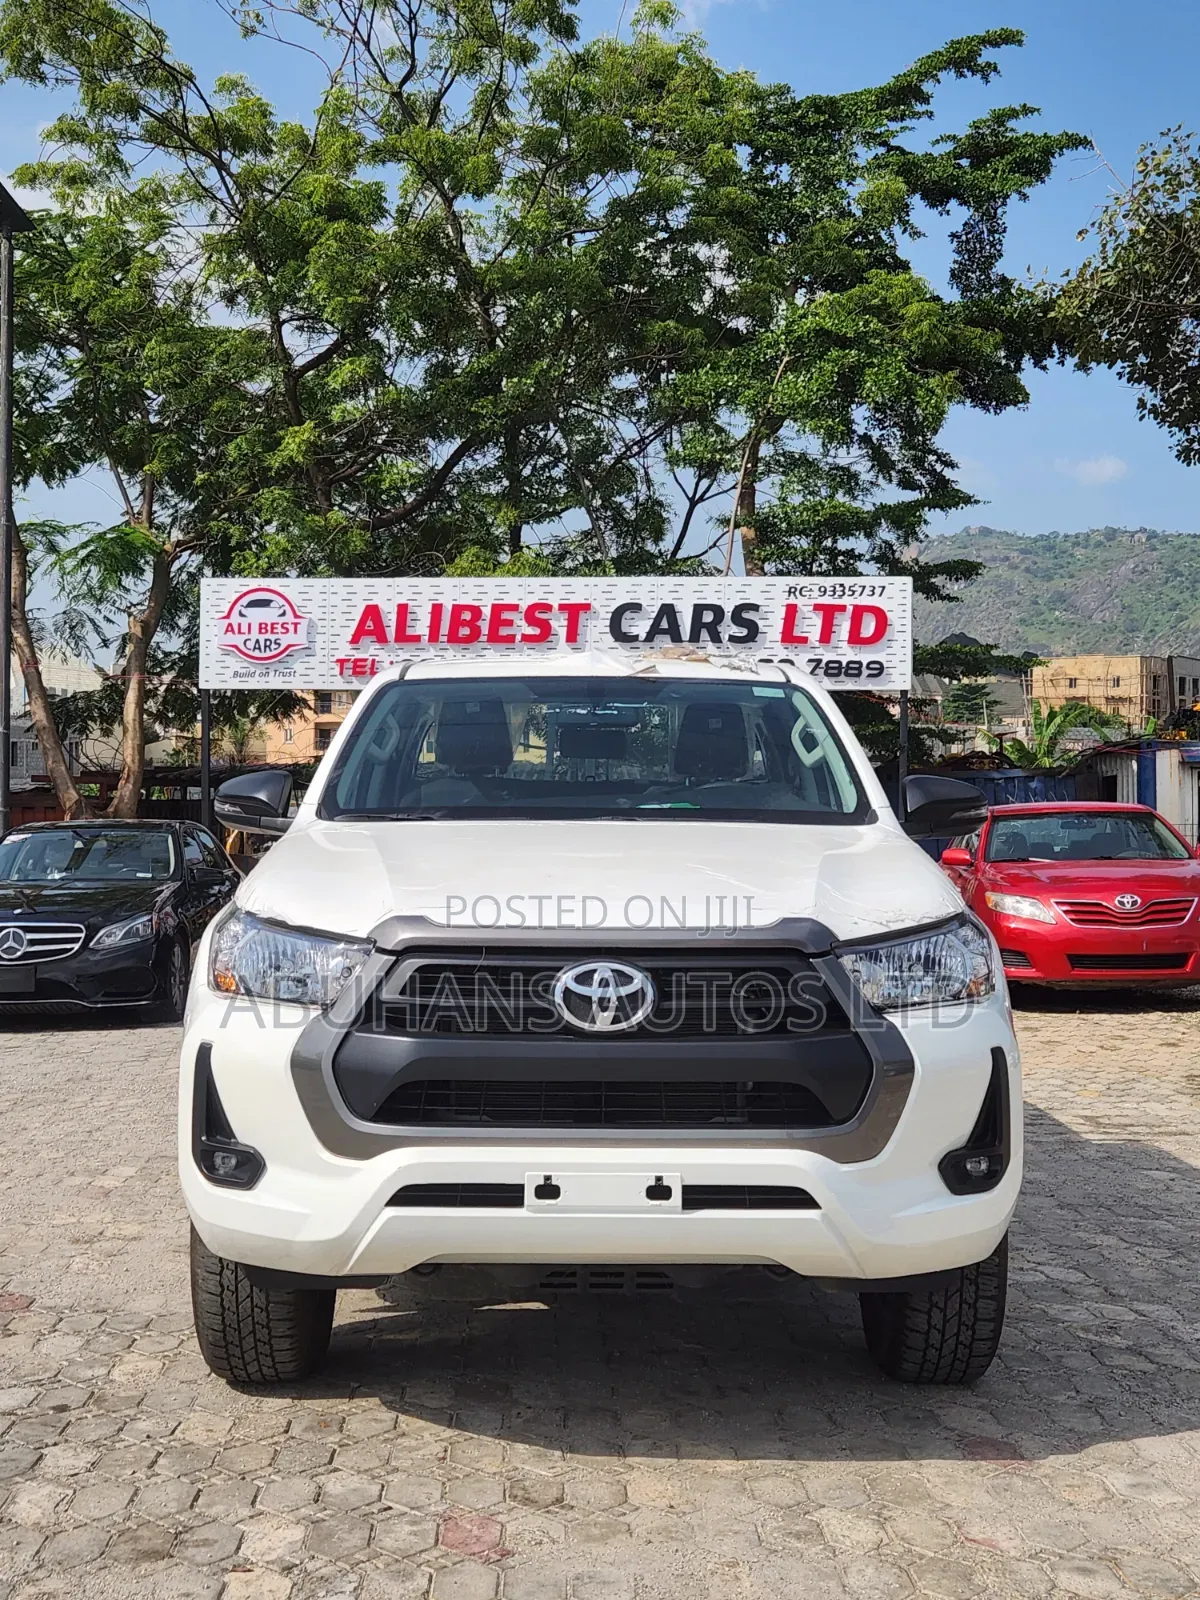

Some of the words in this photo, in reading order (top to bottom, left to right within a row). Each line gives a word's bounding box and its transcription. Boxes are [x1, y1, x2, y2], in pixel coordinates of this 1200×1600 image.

[817, 585, 886, 598] 9335737
[224, 622, 252, 635] ALI
[258, 622, 301, 635] BEST
[349, 603, 591, 645] ALIBEST
[609, 602, 760, 644] CARS
[780, 603, 888, 646] LTD
[243, 638, 282, 653] CARS
[273, 670, 297, 678] Trust
[806, 658, 885, 678] 7889
